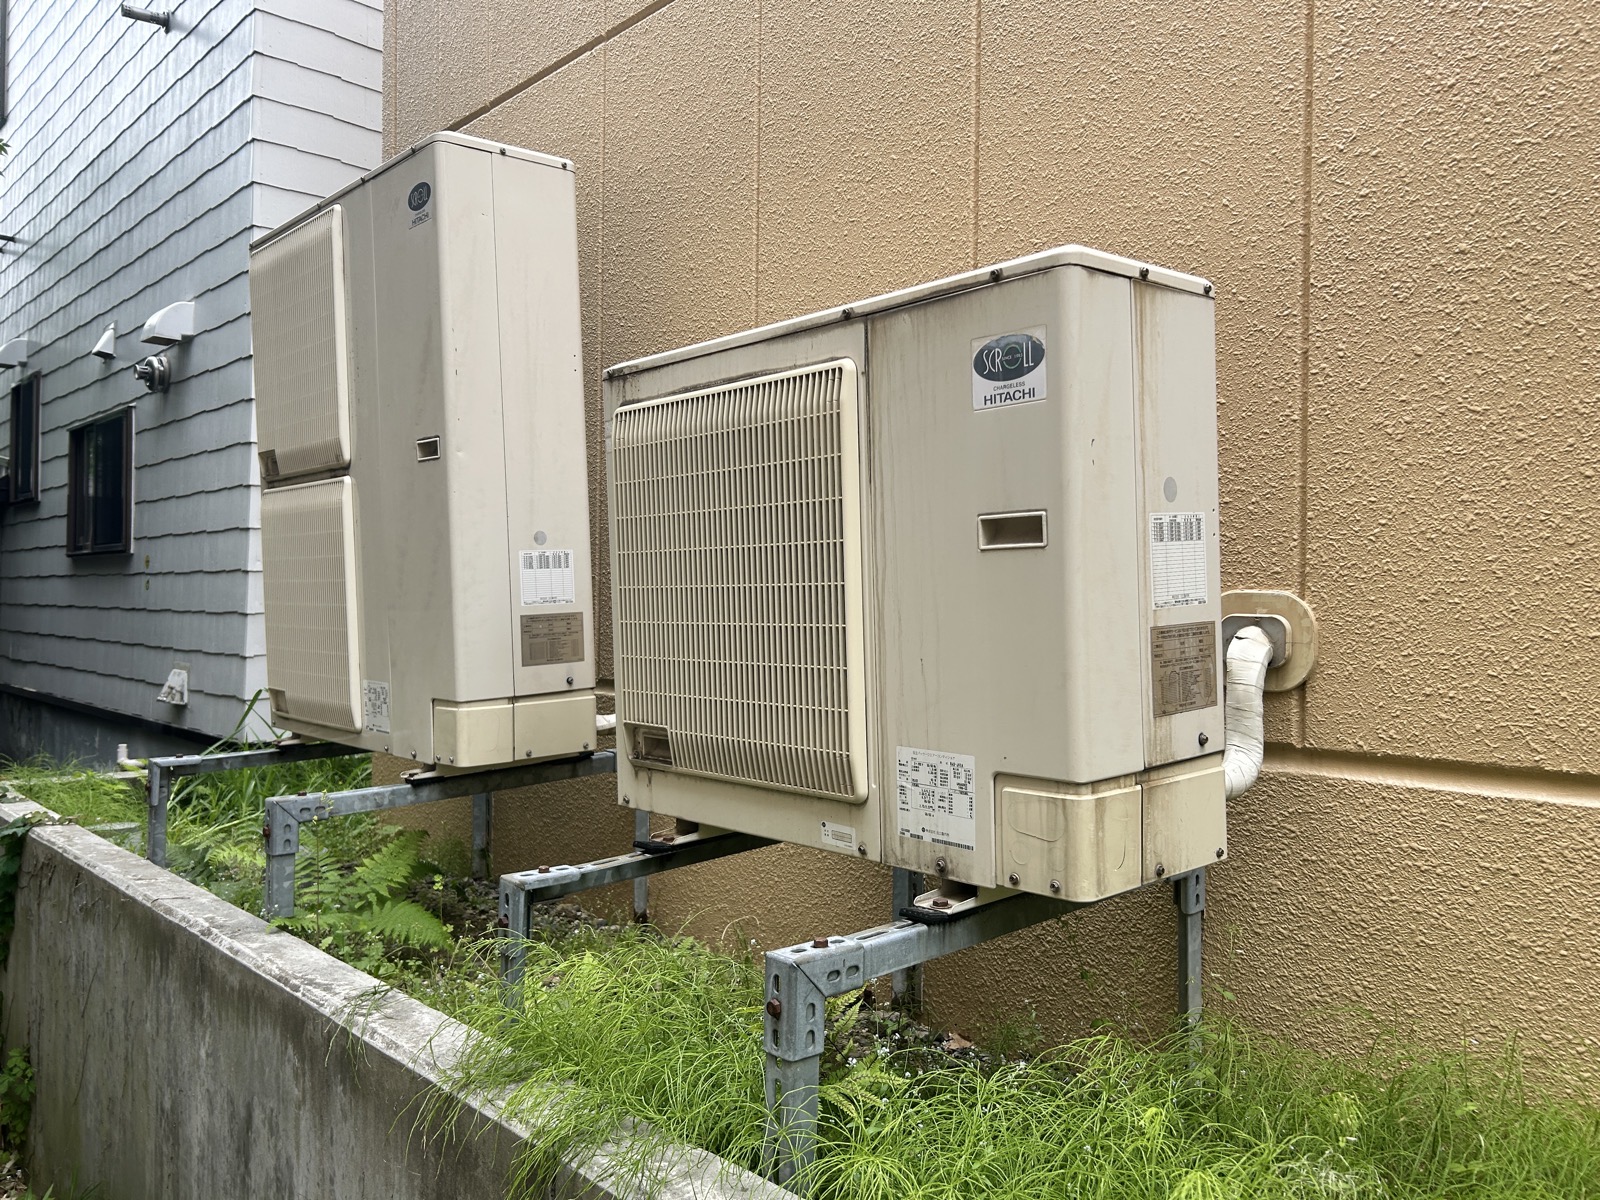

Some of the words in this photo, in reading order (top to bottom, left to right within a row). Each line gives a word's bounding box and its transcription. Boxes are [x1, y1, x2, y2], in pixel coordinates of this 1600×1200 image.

[411, 211, 430, 226] HITACHI
[982, 341, 1034, 375] SCROLL
[993, 381, 1026, 391] CHARGELESS
[983, 387, 1036, 406] HITACHI
